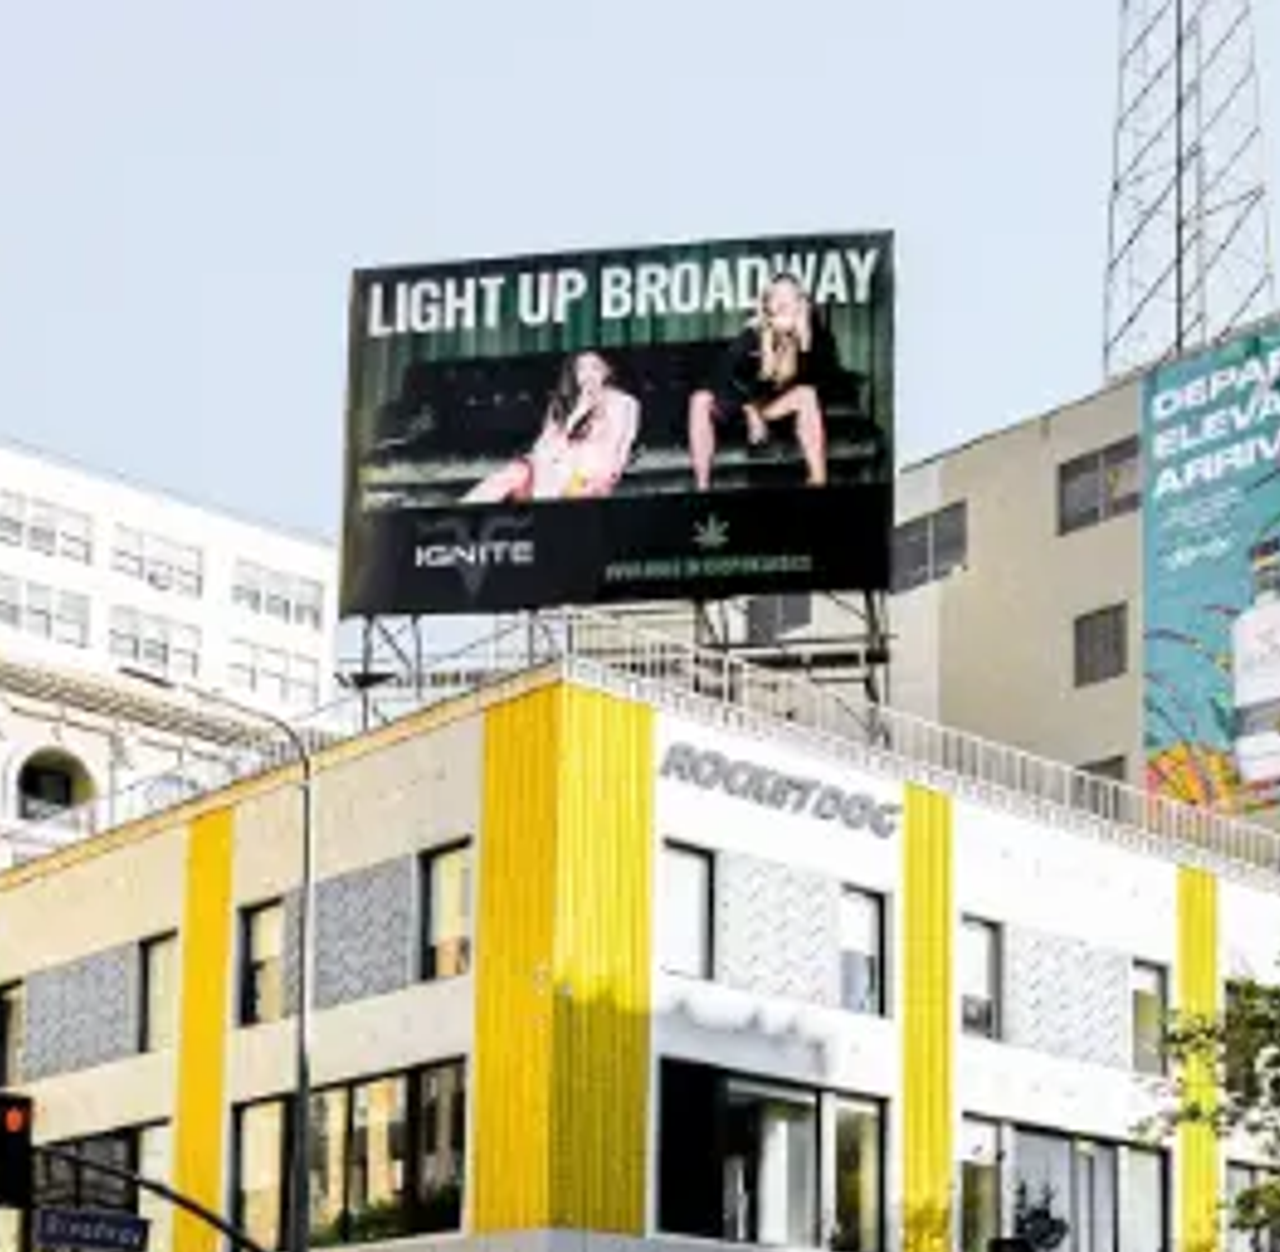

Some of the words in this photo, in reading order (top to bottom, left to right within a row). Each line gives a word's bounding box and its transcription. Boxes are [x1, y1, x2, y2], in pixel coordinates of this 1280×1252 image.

[368, 276, 505, 337] LIGHT
[519, 268, 588, 325] UP
[415, 540, 535, 567] IGNITE
